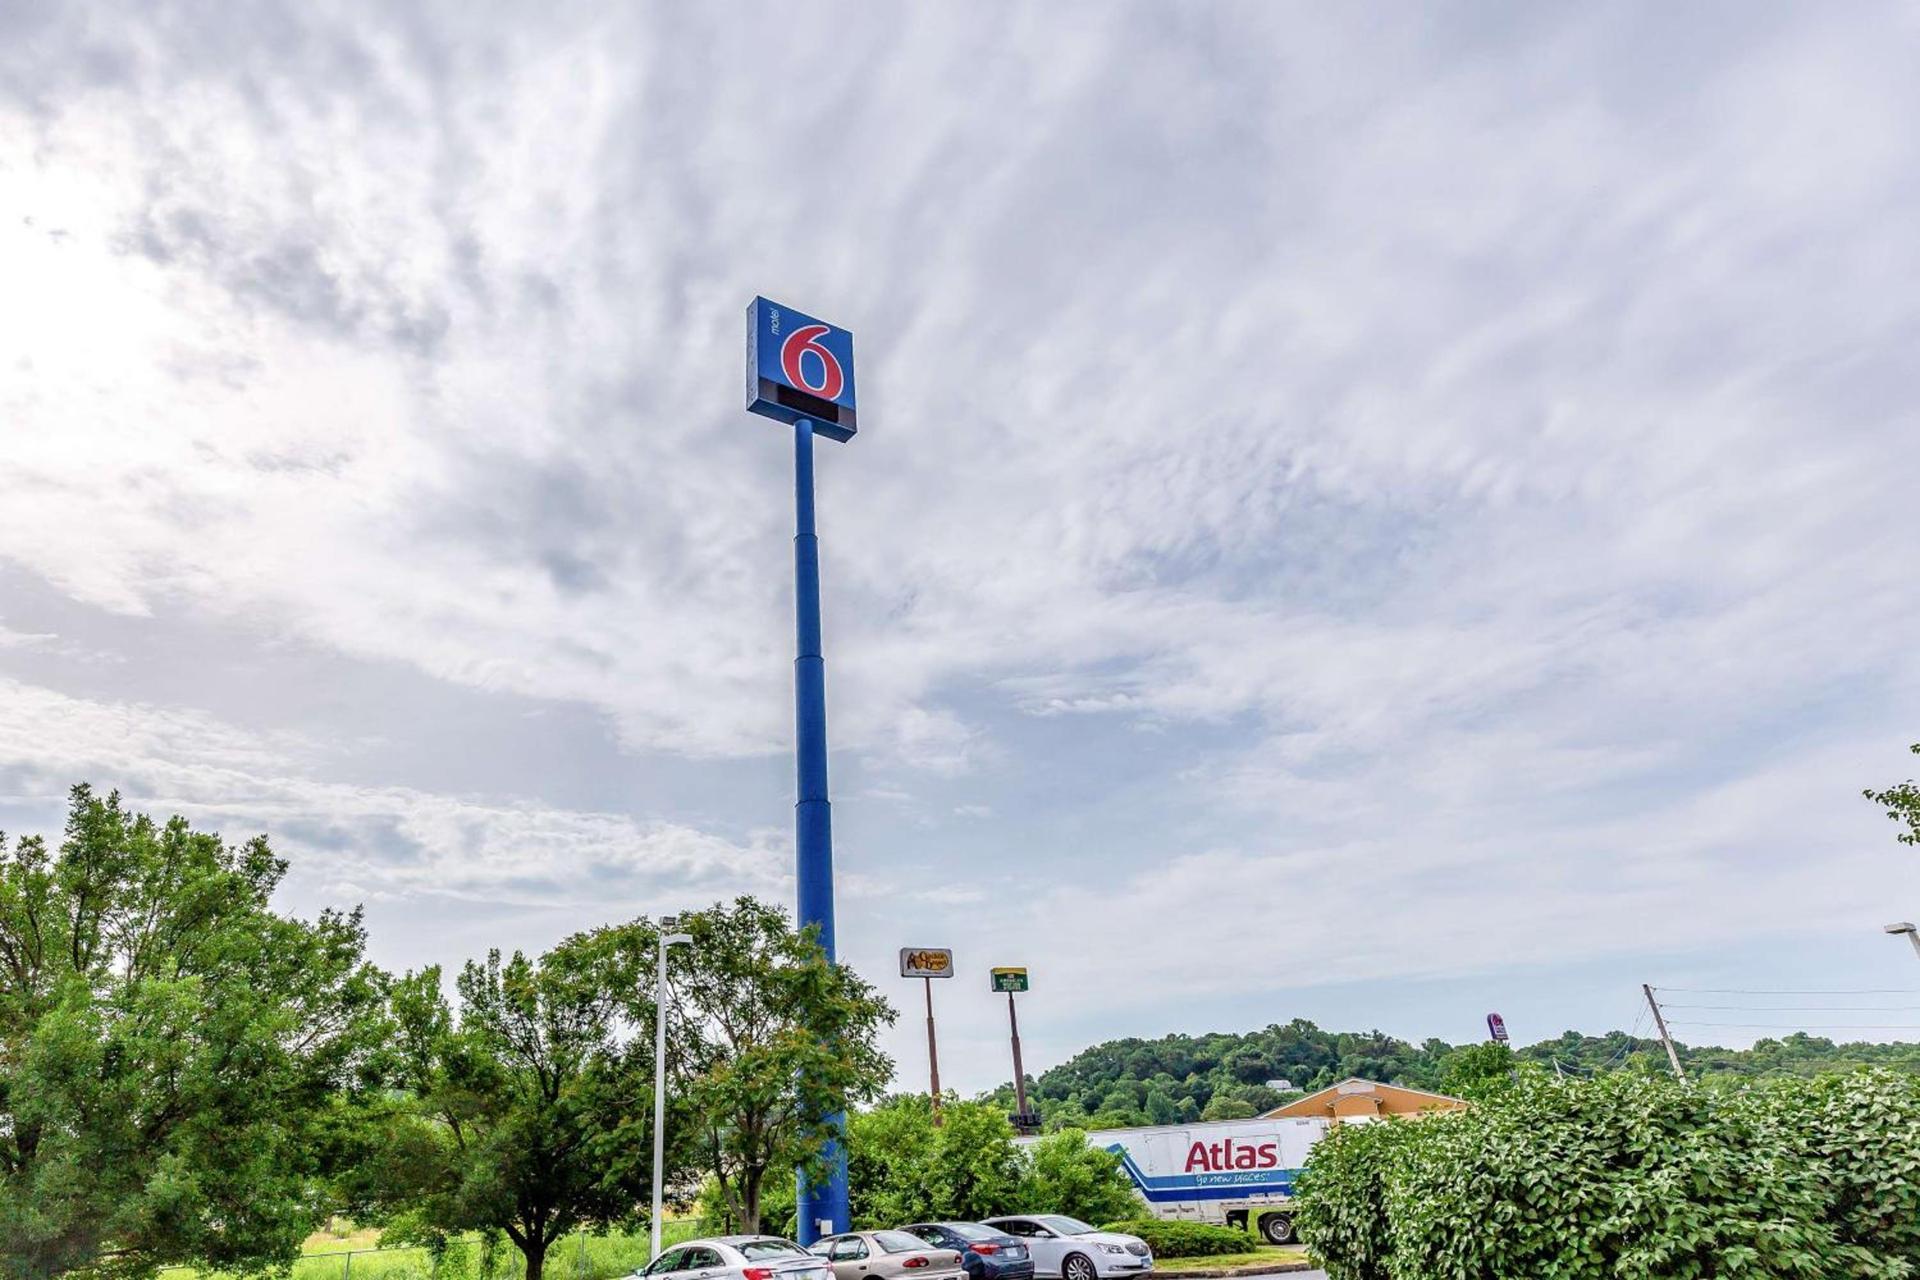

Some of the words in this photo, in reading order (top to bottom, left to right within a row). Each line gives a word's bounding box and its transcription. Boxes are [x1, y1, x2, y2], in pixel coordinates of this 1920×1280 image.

[769, 307, 780, 335] motel
[781, 325, 844, 402] 6
[1185, 1138, 1277, 1172] Atlas
[1196, 1174, 1208, 1185] go
[1209, 1174, 1232, 1183] new
